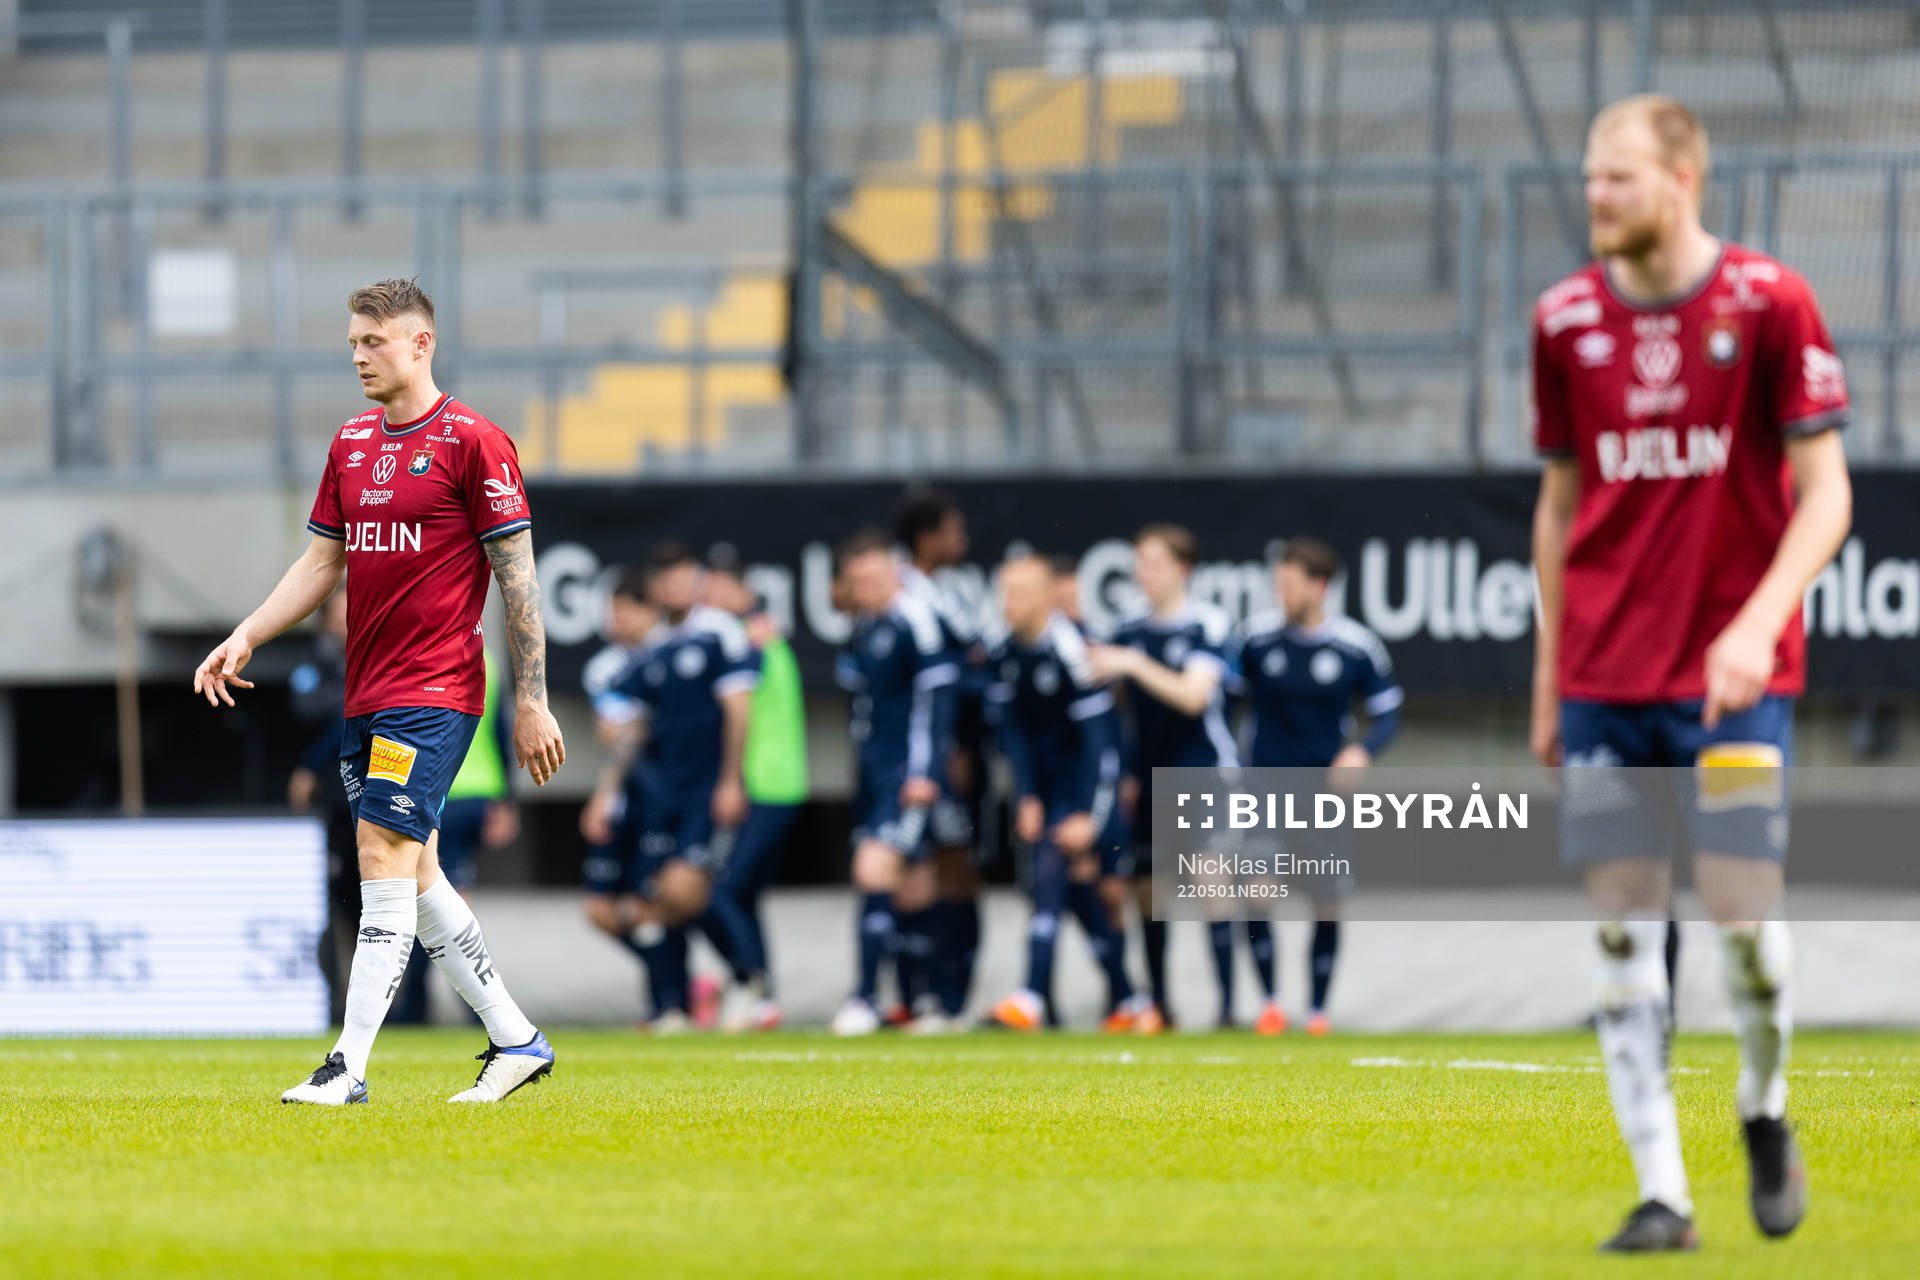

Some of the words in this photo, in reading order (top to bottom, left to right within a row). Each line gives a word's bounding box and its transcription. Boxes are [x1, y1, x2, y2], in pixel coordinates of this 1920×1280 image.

[380, 442, 404, 451] BJELIN
[361, 488, 394, 499] factoring
[1361, 537, 1544, 641] Ulle
[389, 804, 411, 815] umbro
